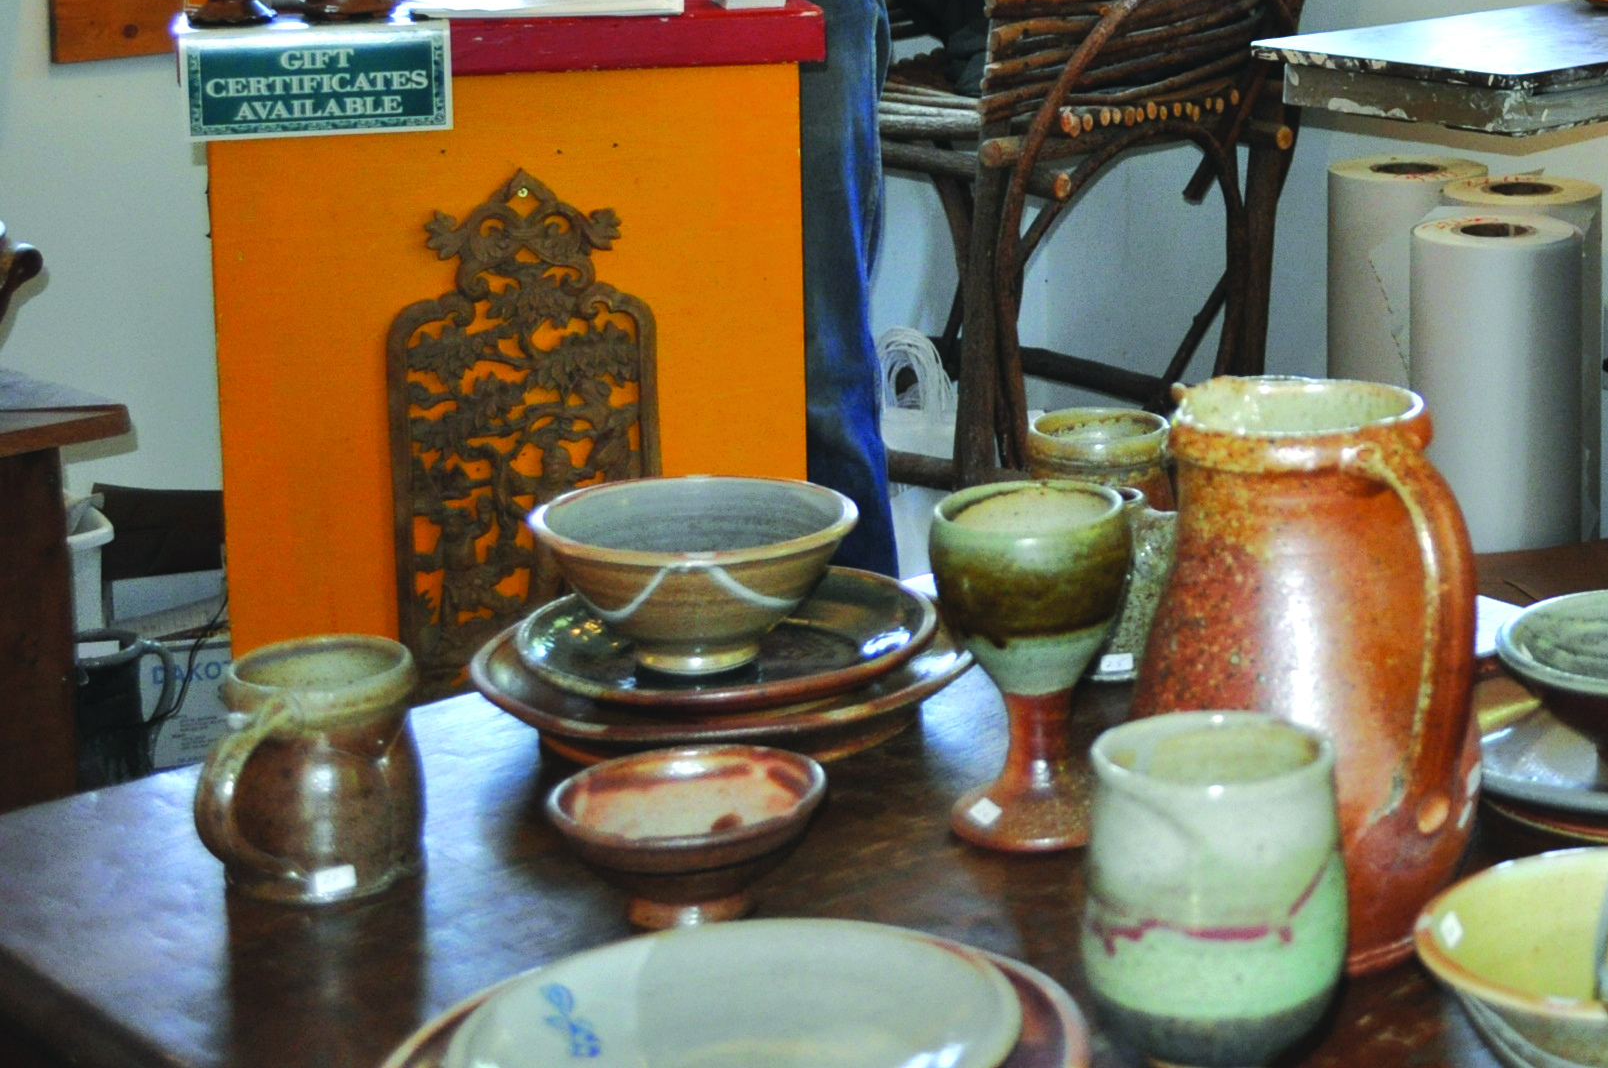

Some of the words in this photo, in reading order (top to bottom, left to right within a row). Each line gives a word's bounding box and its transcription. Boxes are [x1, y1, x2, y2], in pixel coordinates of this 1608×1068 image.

[280, 48, 354, 70] GIFT
[205, 70, 429, 98] CERTIFICATES
[233, 95, 403, 121] AVAILABLE
